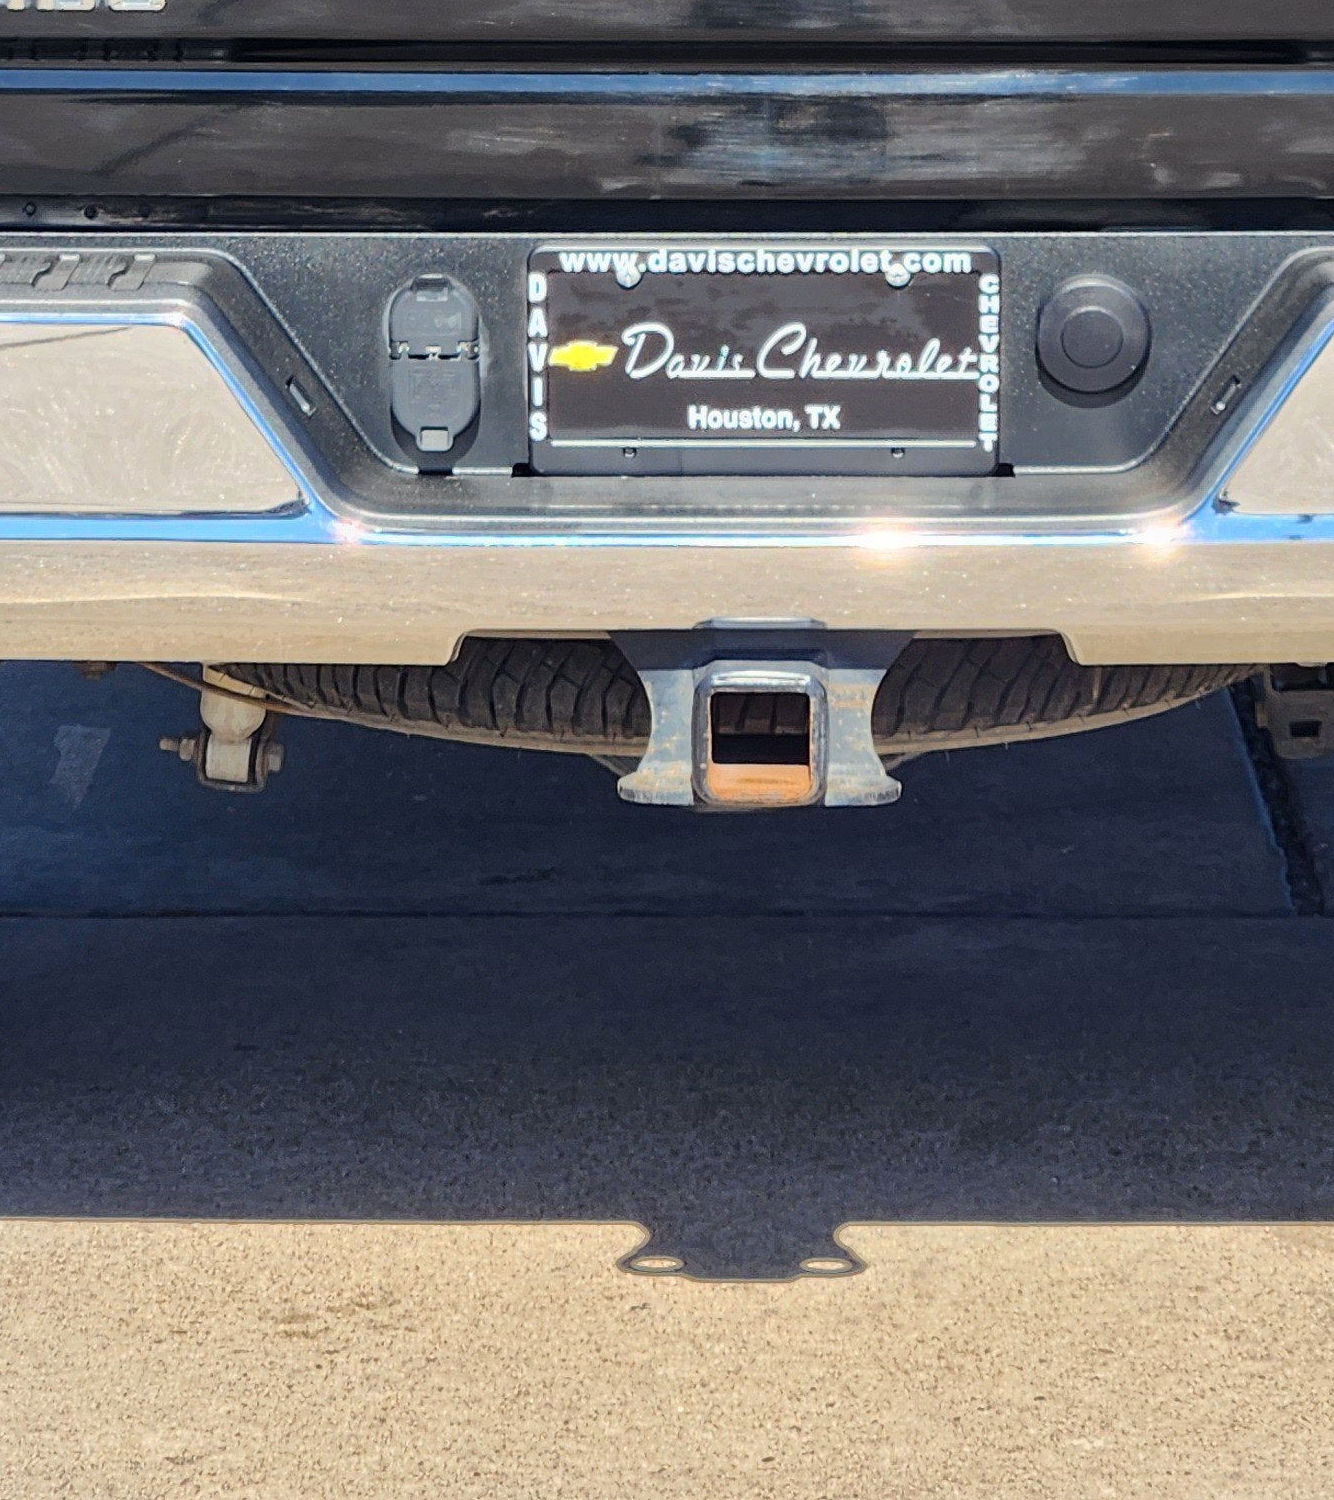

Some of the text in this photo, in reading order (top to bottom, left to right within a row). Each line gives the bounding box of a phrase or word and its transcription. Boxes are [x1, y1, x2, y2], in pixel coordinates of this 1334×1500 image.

[558, 248, 972, 274] www.davischevroletcom
[527, 272, 548, 442] DAVIS
[621, 322, 980, 380] Davis Chevrolet
[978, 273, 1000, 452] CHEVROLET
[687, 404, 842, 433] Houston, TX
